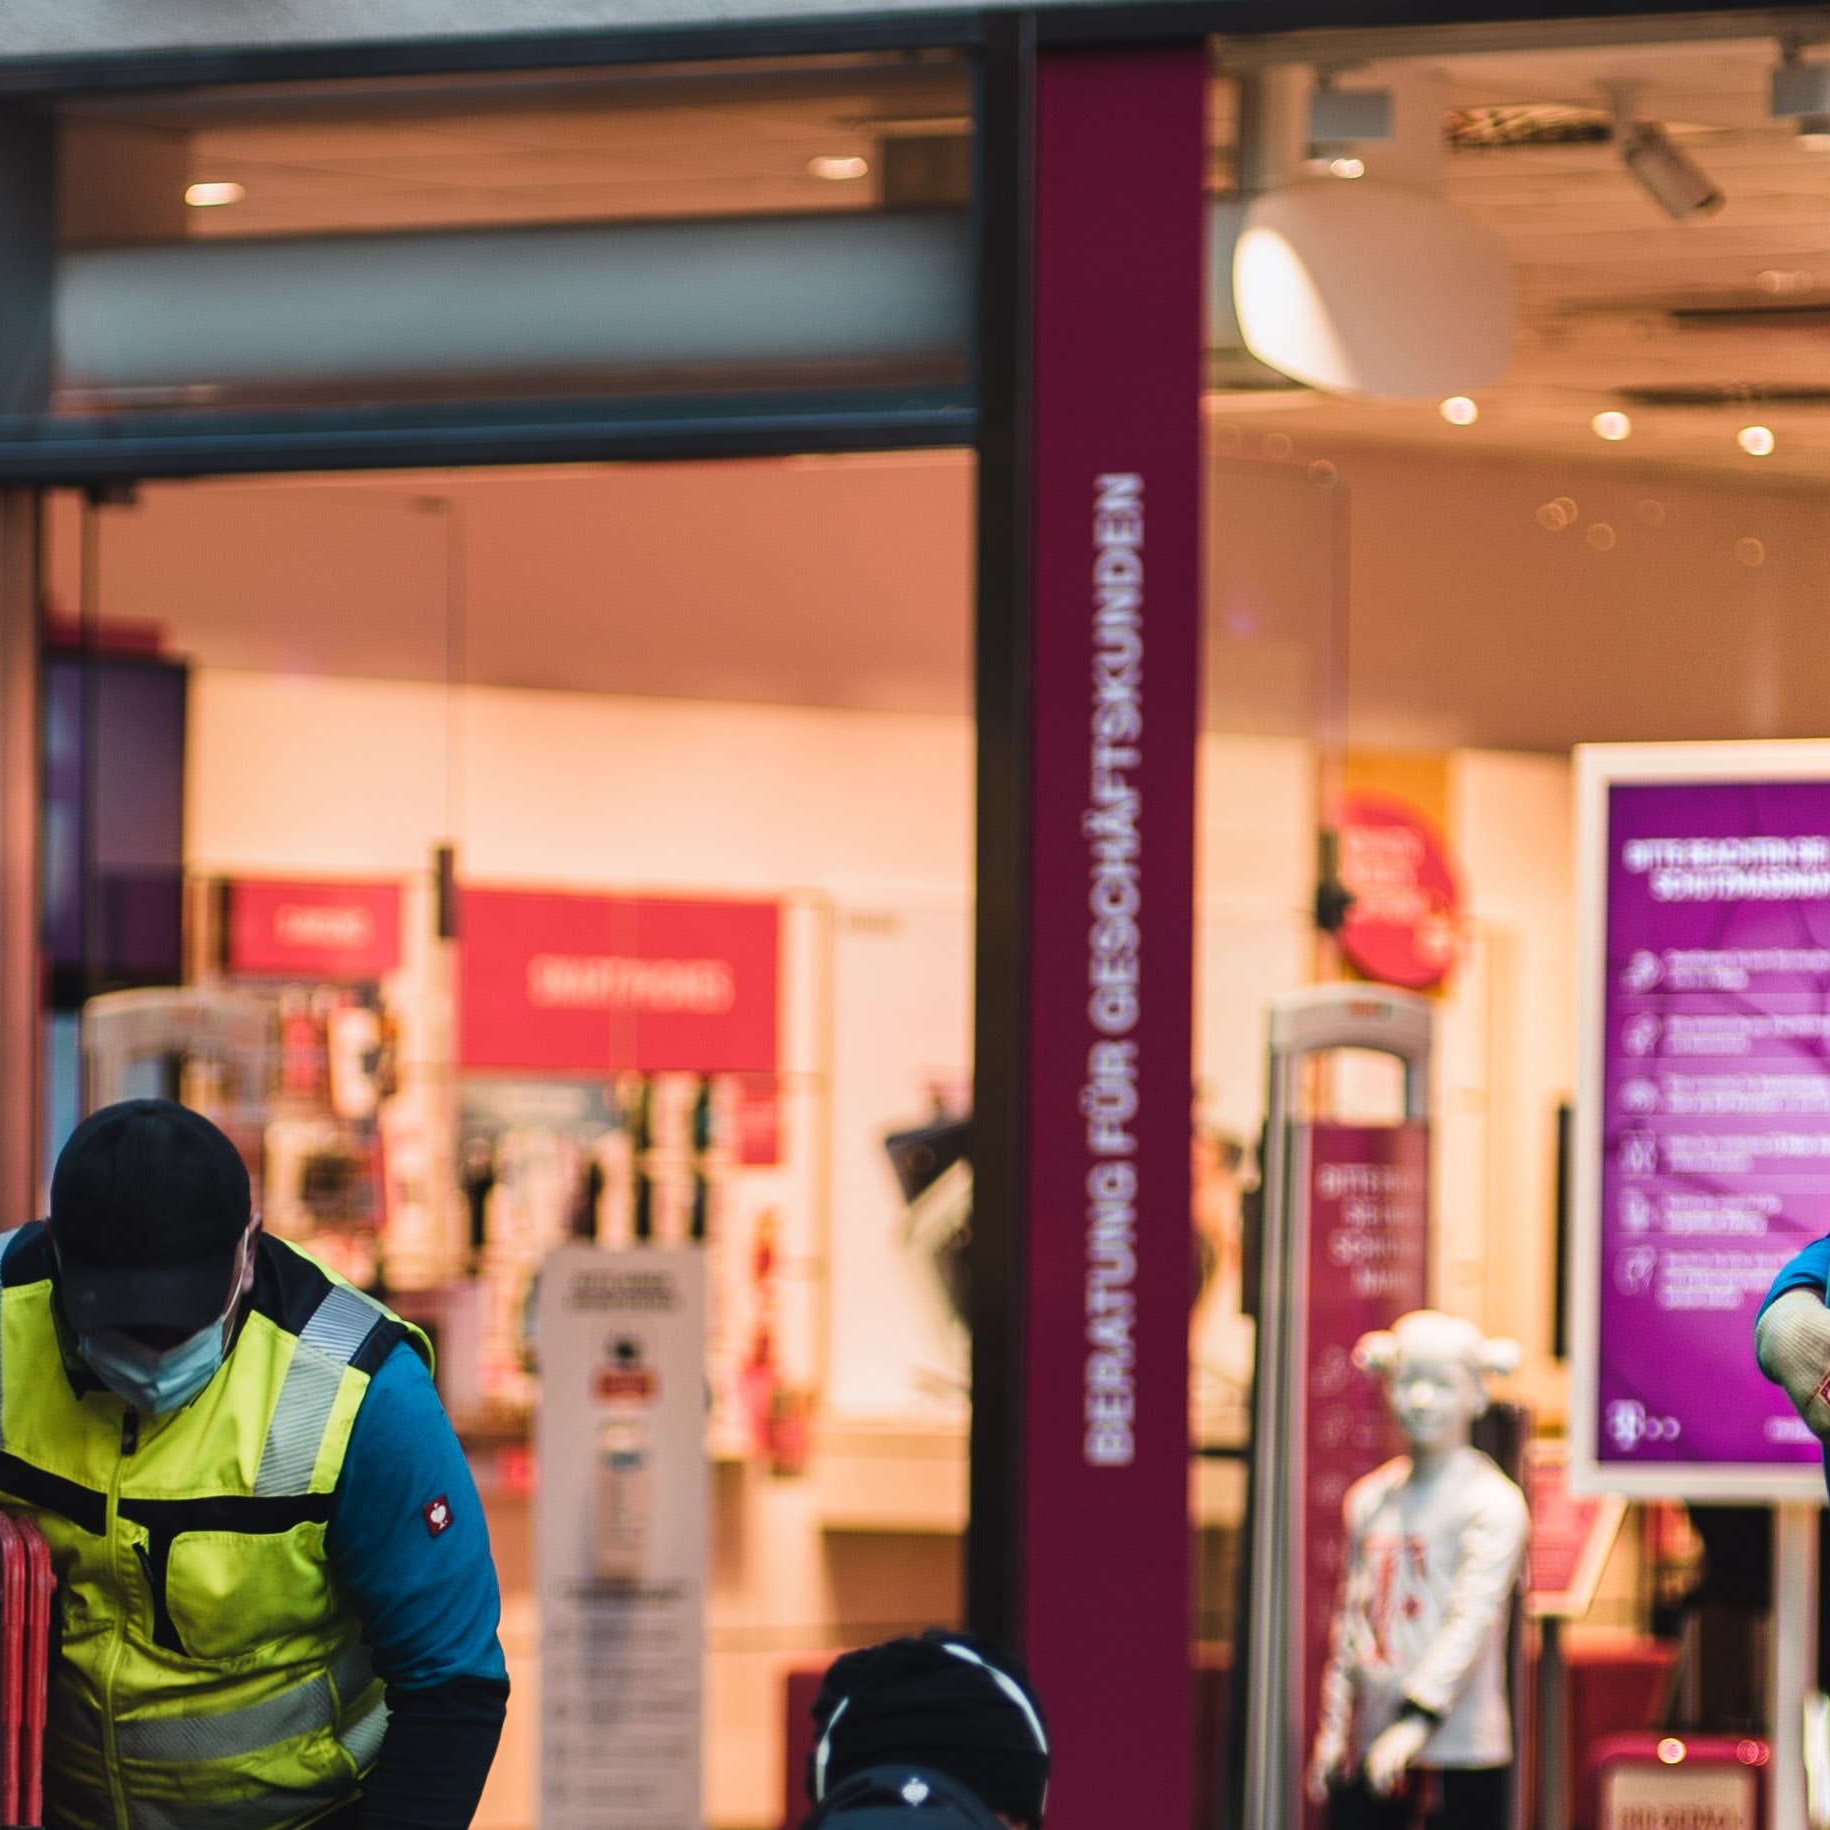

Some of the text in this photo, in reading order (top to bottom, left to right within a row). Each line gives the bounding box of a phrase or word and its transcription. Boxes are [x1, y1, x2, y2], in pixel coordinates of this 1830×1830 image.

[1079, 473, 1145, 1467] BERATUNG FÜR GESCHÄFTSKUNDEN
